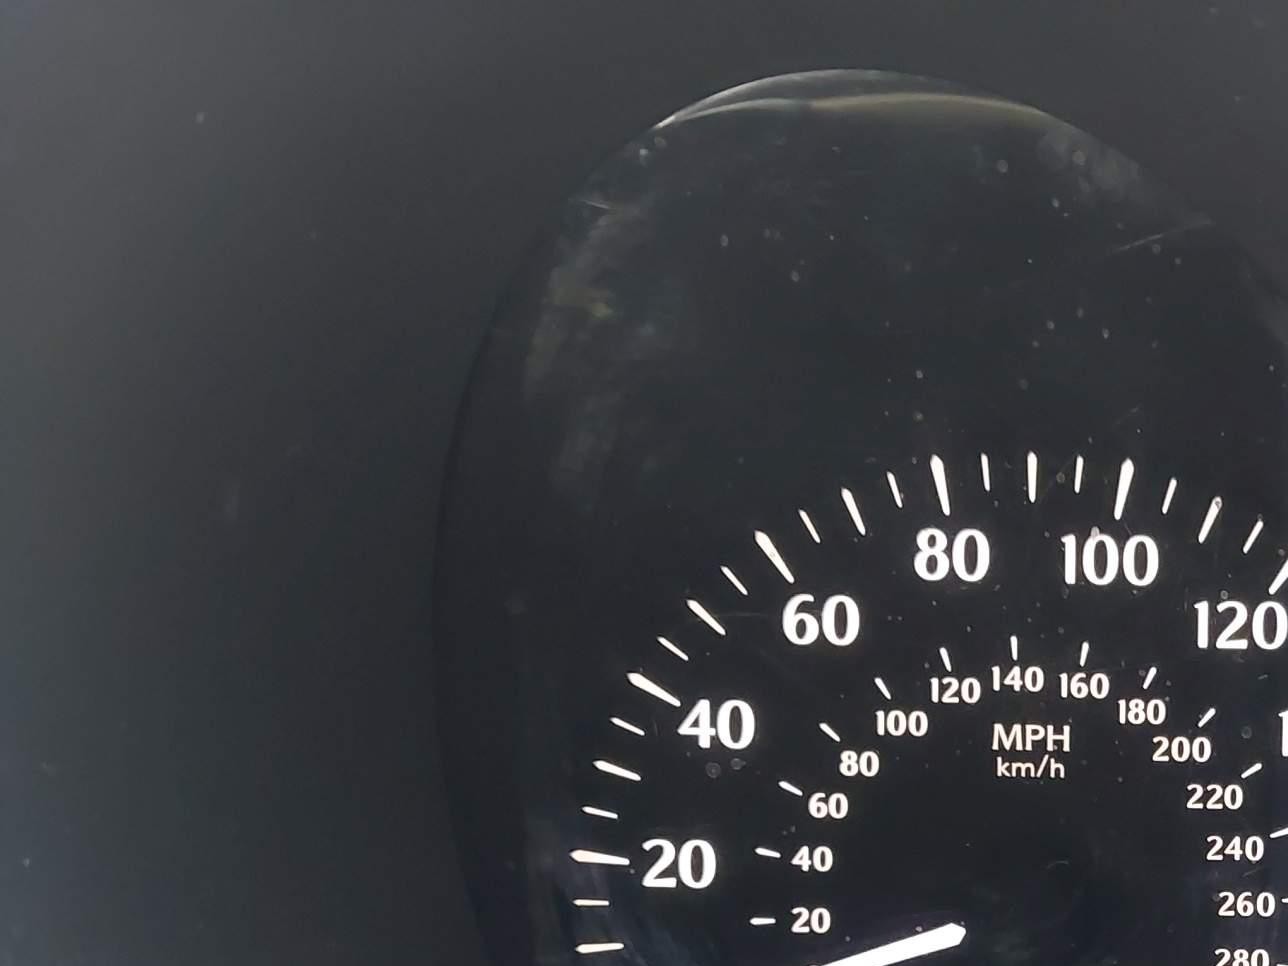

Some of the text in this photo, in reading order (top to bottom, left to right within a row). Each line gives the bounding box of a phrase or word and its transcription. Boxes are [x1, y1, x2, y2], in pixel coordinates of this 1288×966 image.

[913, 527, 990, 582] 80
[1060, 534, 1159, 587] 100
[782, 593, 860, 647] 60
[1193, 600, 1288, 650] 120
[930, 676, 981, 704] 120
[991, 665, 1045, 693] 140
[1059, 672, 1110, 699] 160
[677, 699, 755, 750] 40
[875, 709, 929, 737] 100
[1117, 698, 1166, 725] 180
[991, 723, 1071, 752] MPH
[1152, 735, 1212, 763] 200
[839, 750, 880, 777] 80
[996, 756, 1065, 779] km/h
[808, 792, 849, 819] 60
[1186, 783, 1244, 810] 220
[791, 845, 834, 873] 40
[1206, 835, 1265, 862] 240
[642, 838, 717, 889] 20
[1218, 891, 1276, 917] 260
[791, 906, 831, 934] 20
